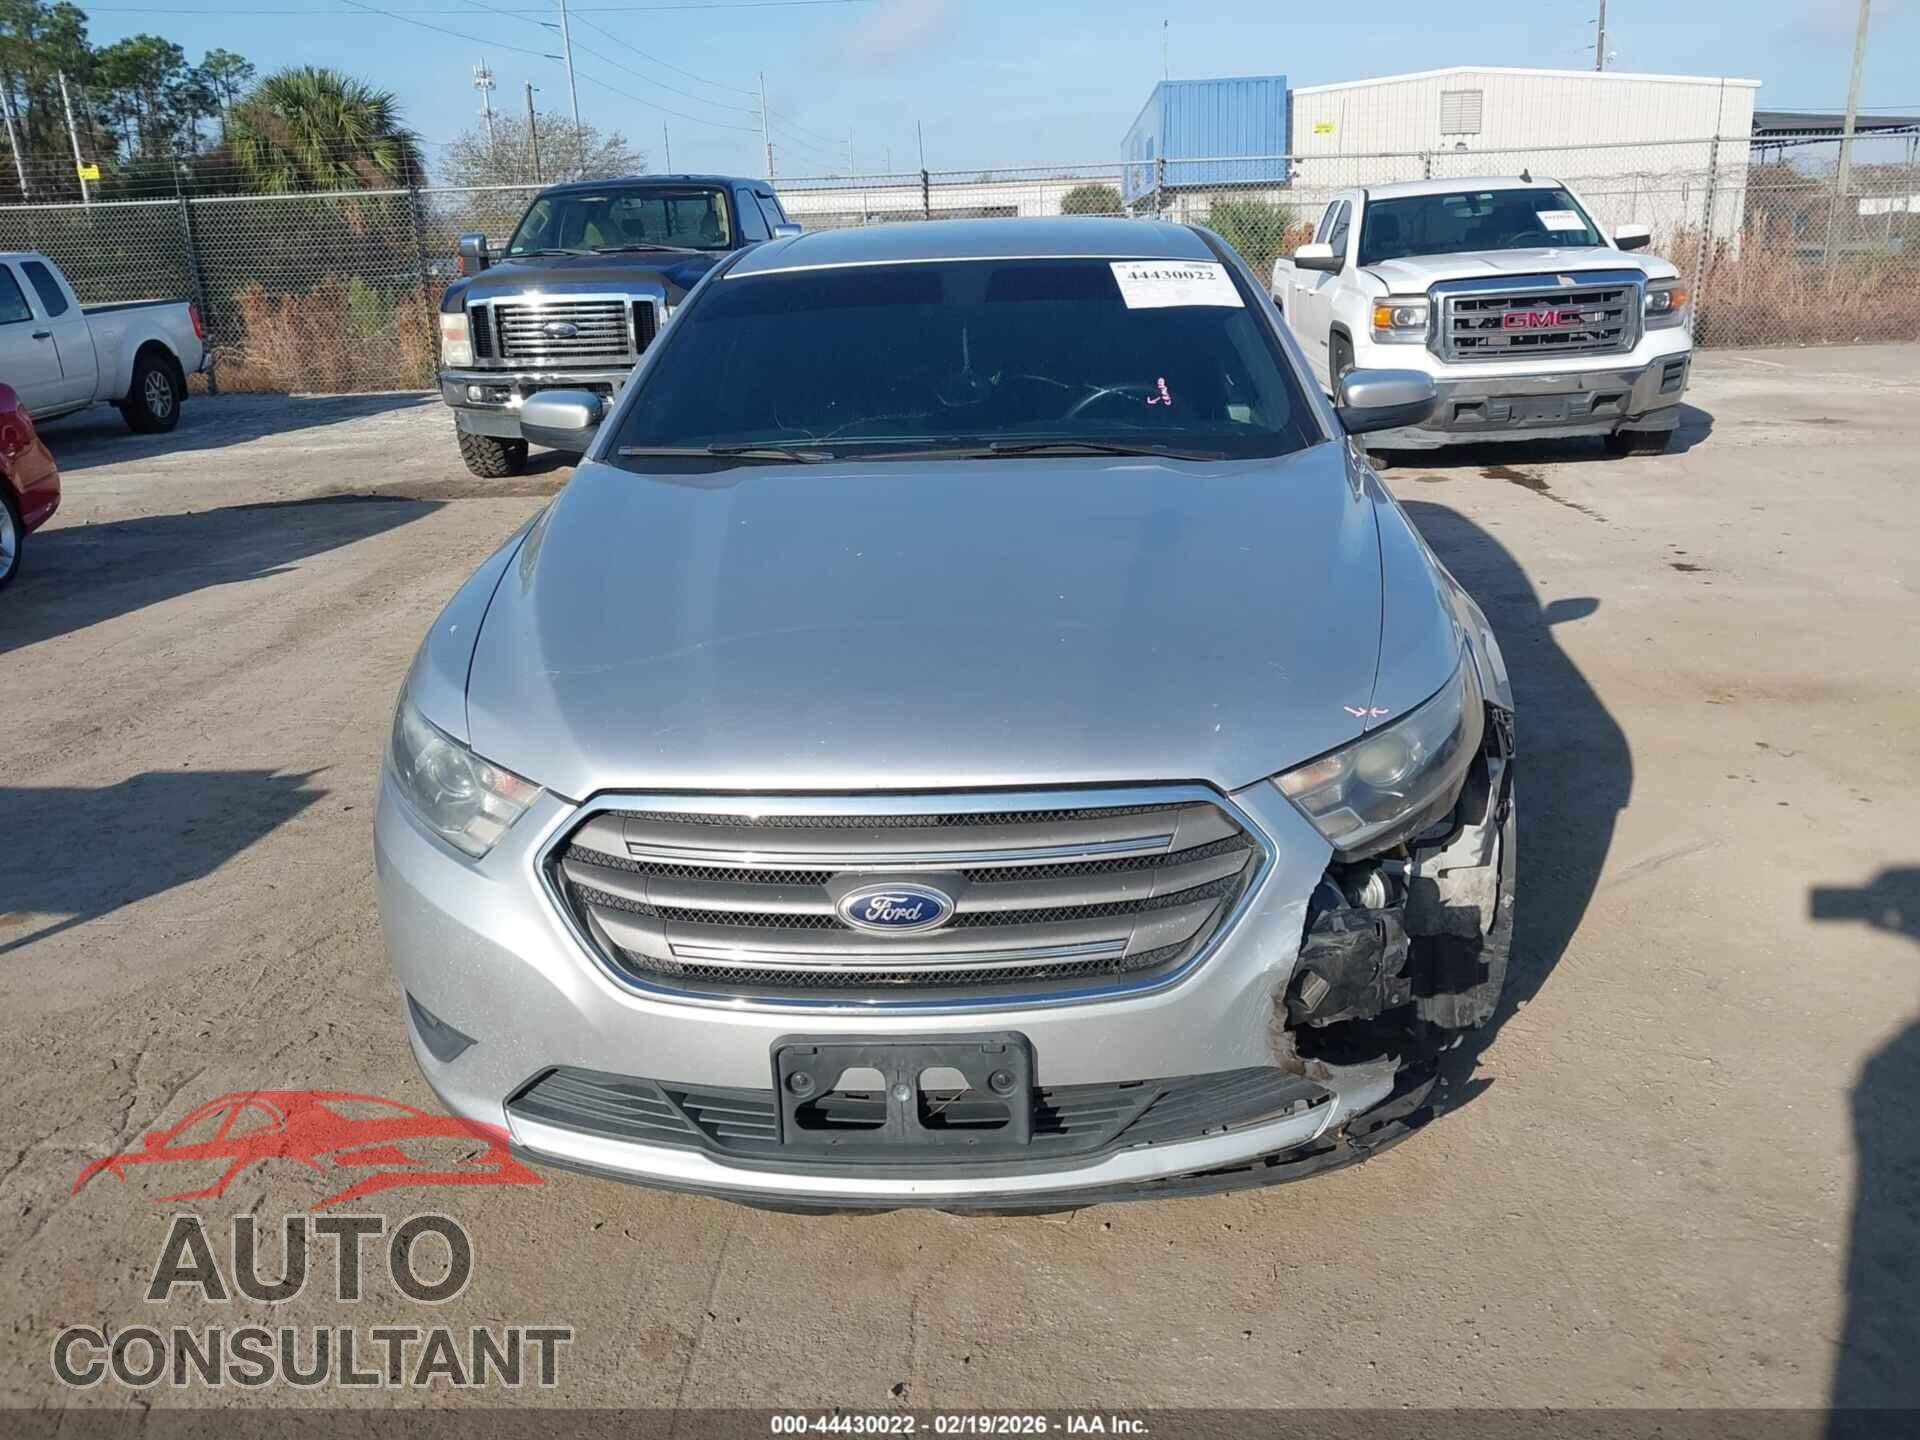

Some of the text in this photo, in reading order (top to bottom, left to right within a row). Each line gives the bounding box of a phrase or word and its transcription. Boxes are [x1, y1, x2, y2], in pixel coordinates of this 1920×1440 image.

[1127, 270, 1217, 280] 44430022
[1504, 309, 1582, 329] GMC
[865, 896, 922, 920] Ford
